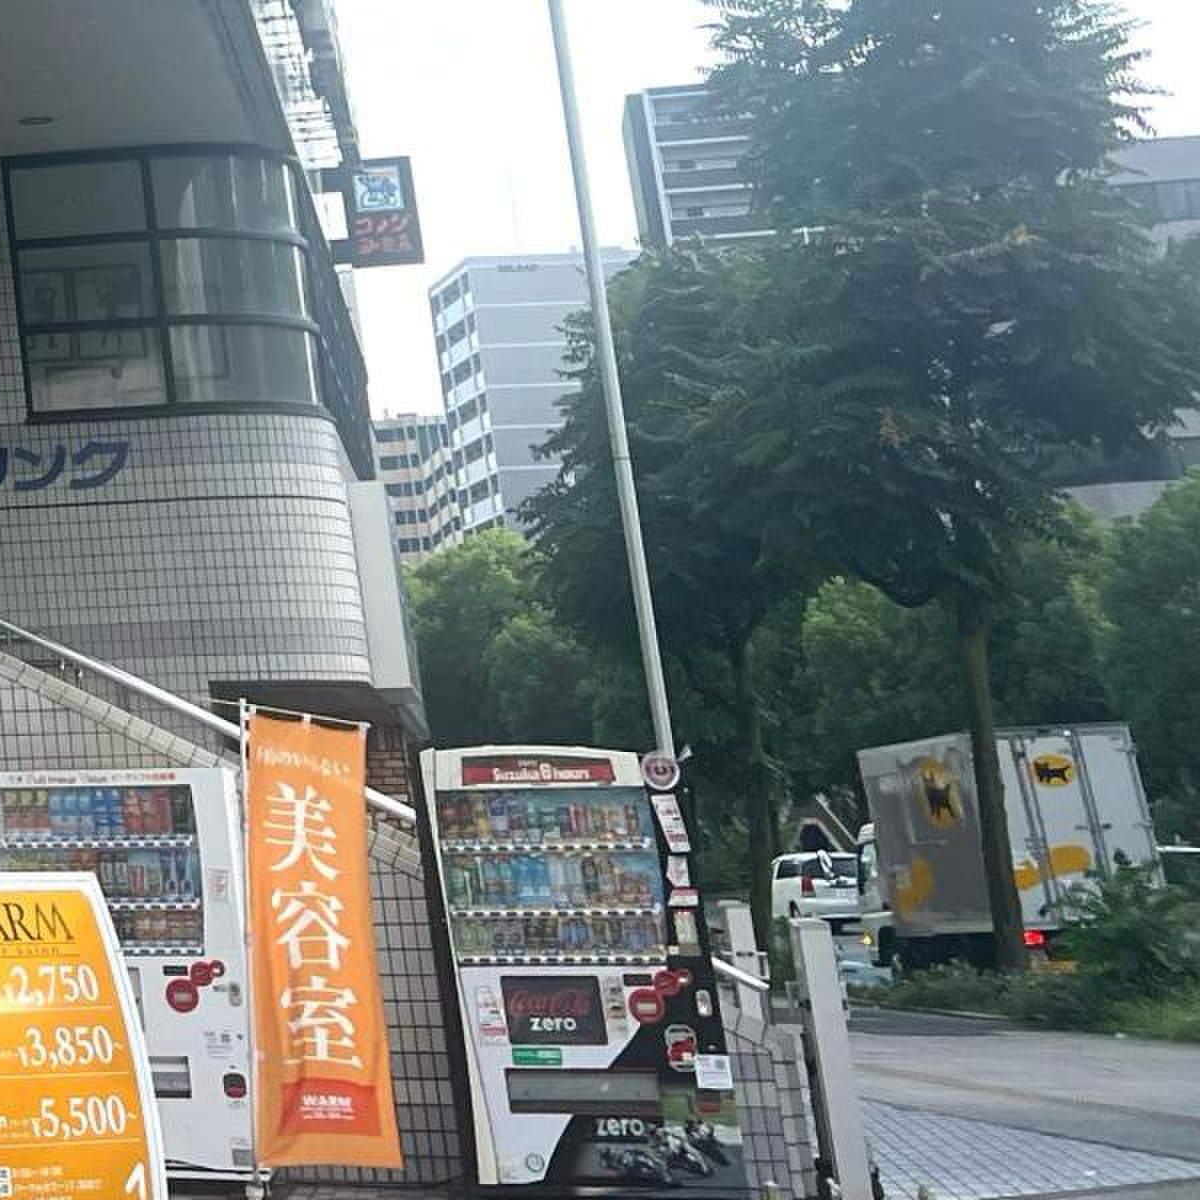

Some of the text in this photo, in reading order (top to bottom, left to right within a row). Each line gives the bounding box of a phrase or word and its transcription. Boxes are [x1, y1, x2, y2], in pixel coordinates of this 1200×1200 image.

[262, 781, 363, 1071] 美容室
[529, 1016, 577, 1032] zero
[596, 1117, 645, 1137] zero
